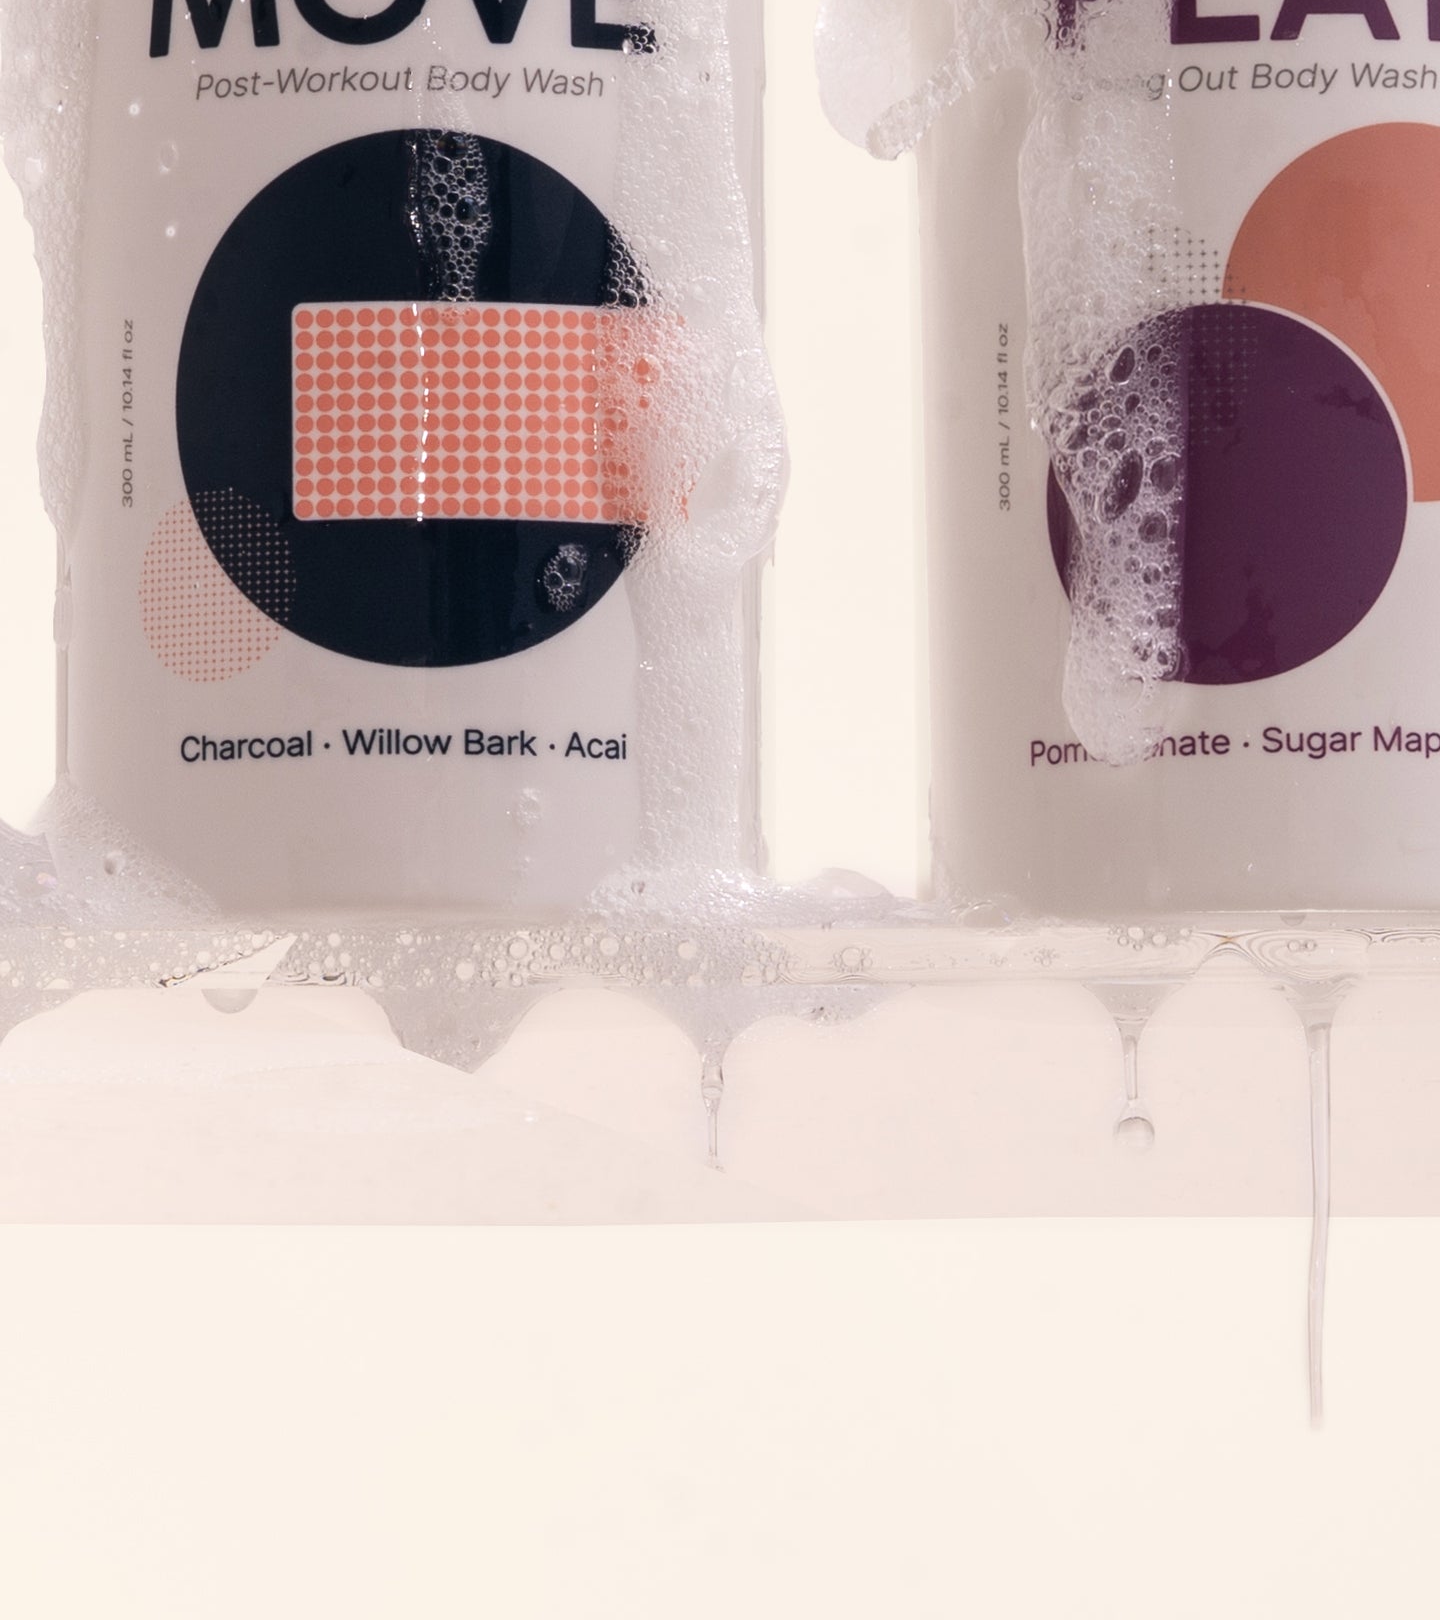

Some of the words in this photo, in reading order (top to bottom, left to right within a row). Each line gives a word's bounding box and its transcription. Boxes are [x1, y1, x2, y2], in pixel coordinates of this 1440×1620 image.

[196, 65, 414, 101] Post-Workout
[426, 65, 511, 98] Body
[522, 65, 605, 98] Wash
[1178, 64, 1237, 95] Out
[1251, 62, 1340, 94] Body
[1351, 62, 1438, 90] Wash
[123, 319, 133, 343] oz
[998, 323, 1008, 347] oz
[122, 468, 133, 508] 300
[998, 472, 1010, 511] 300
[181, 731, 312, 762] Charcoal
[342, 728, 452, 756] Willow
[463, 729, 537, 756] Bark
[564, 732, 627, 760] Acai
[1031, 731, 1230, 767] Pomnate
[1262, 726, 1361, 760] Sugar
